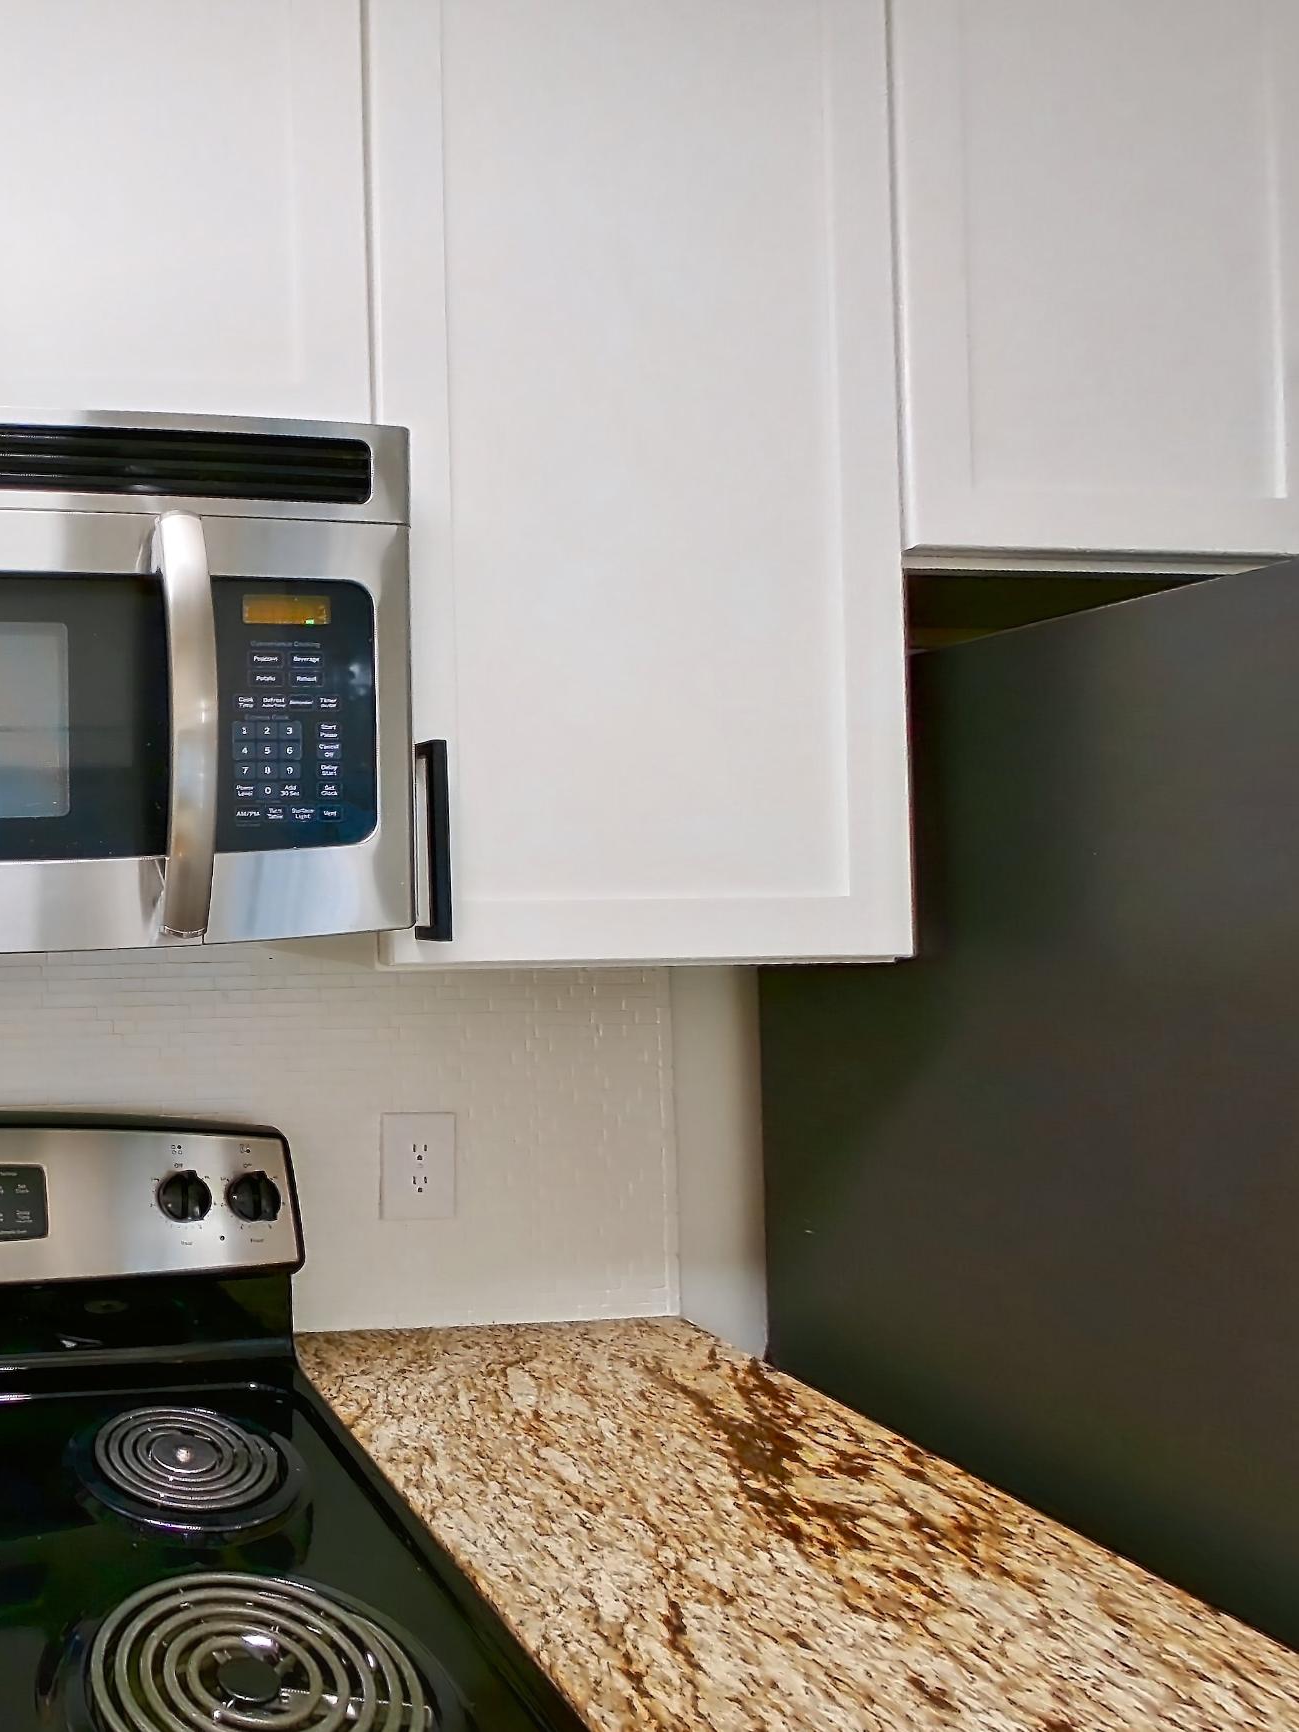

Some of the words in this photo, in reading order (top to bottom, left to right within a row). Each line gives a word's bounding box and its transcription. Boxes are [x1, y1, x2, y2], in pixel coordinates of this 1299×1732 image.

[292, 655, 320, 663] Beverage
[255, 674, 276, 682] Potato
[241, 727, 247, 735] 1
[264, 727, 271, 735] 2
[286, 727, 293, 735] 3
[242, 766, 249, 774] 7
[264, 766, 271, 774] 8
[286, 766, 293, 774] 9
[320, 764, 338, 772] Delay
[323, 810, 337, 818] Vent
